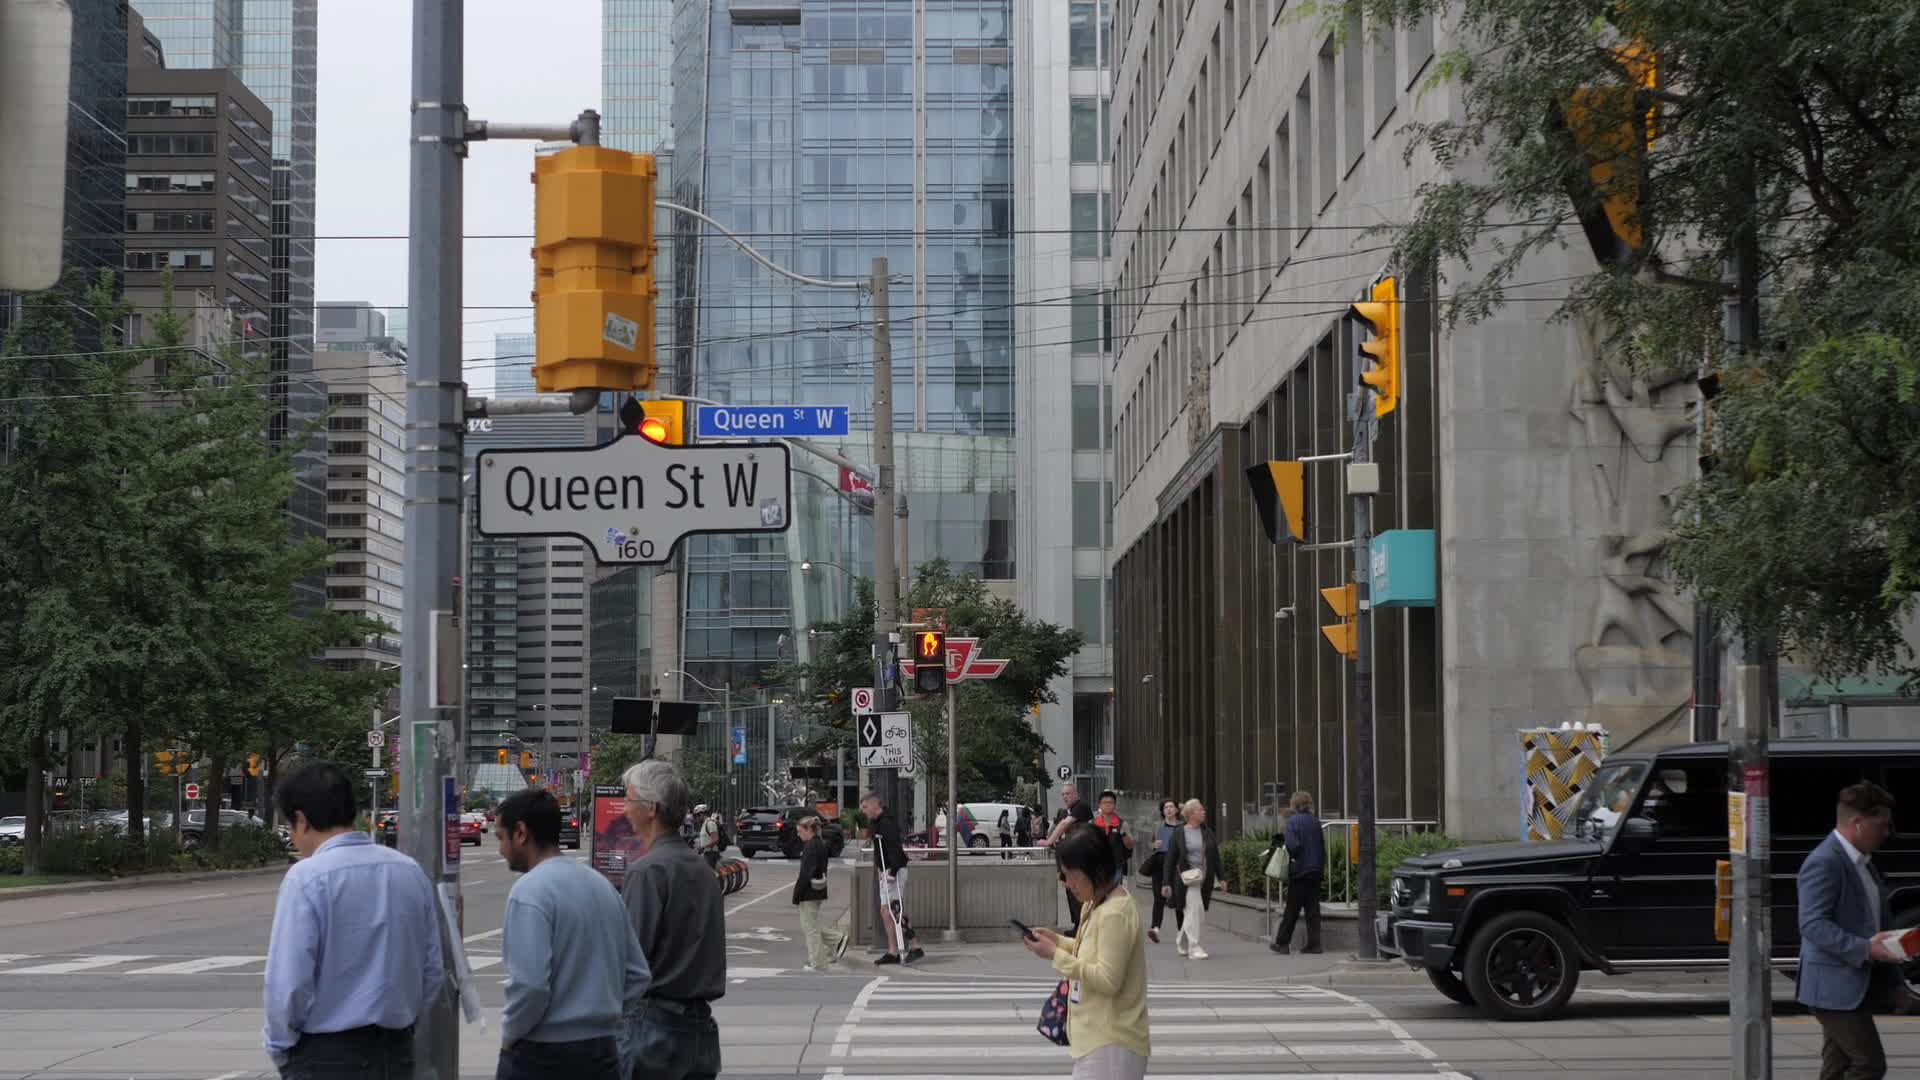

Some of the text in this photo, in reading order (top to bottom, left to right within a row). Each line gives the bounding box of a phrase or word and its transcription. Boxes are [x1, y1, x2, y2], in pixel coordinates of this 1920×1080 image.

[713, 408, 834, 432] Queen St W
[505, 461, 759, 516] Queen St W
[884, 747, 902, 756] THIS
[882, 756, 905, 765] LANE
[1060, 767, 1070, 778] P
